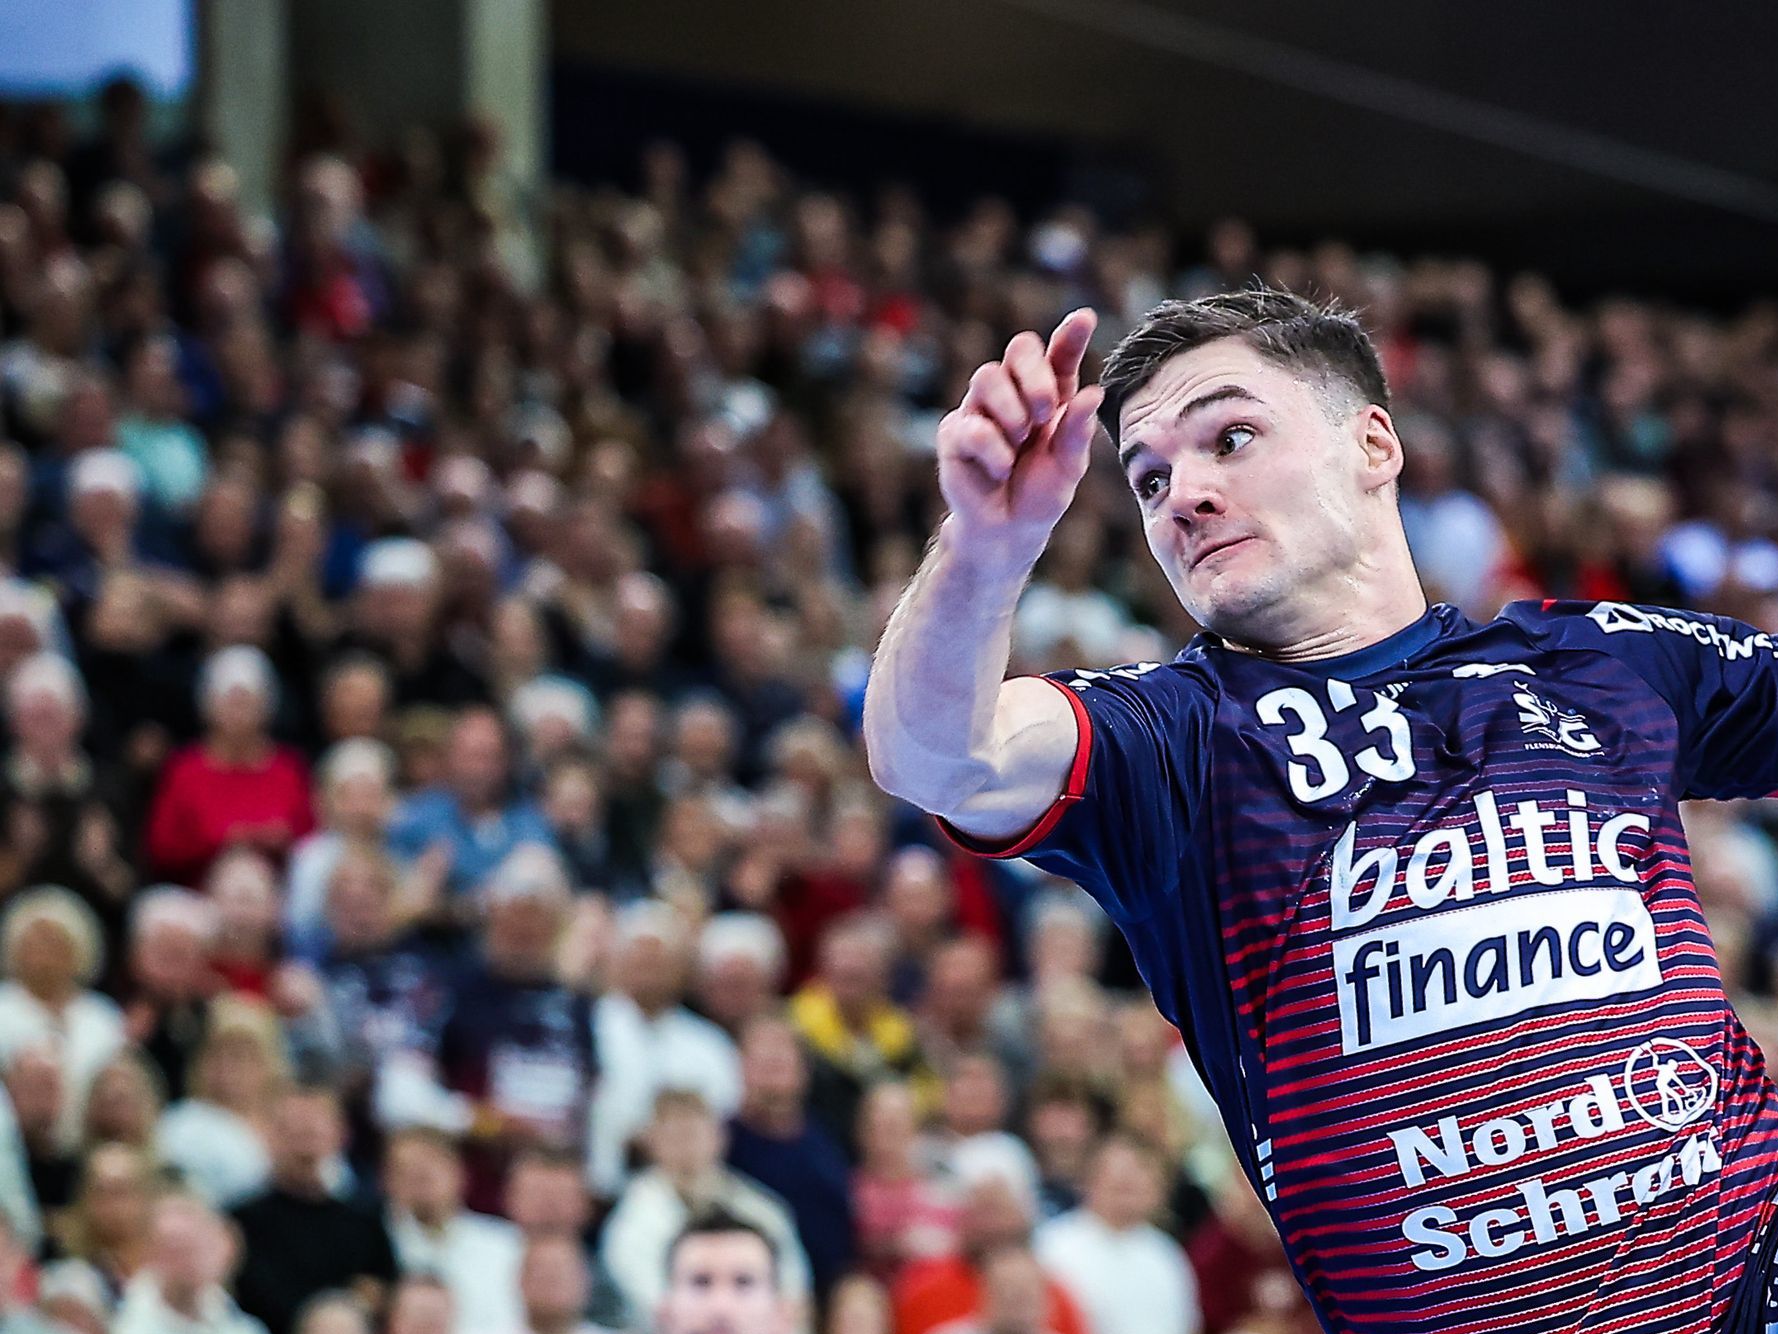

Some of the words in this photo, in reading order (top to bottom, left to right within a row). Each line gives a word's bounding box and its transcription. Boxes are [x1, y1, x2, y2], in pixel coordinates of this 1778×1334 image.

[1254, 677, 1417, 804] 33
[1330, 788, 1651, 933] baltic
[1345, 920, 1645, 1048] finance
[1386, 1073, 1626, 1190] Nord
